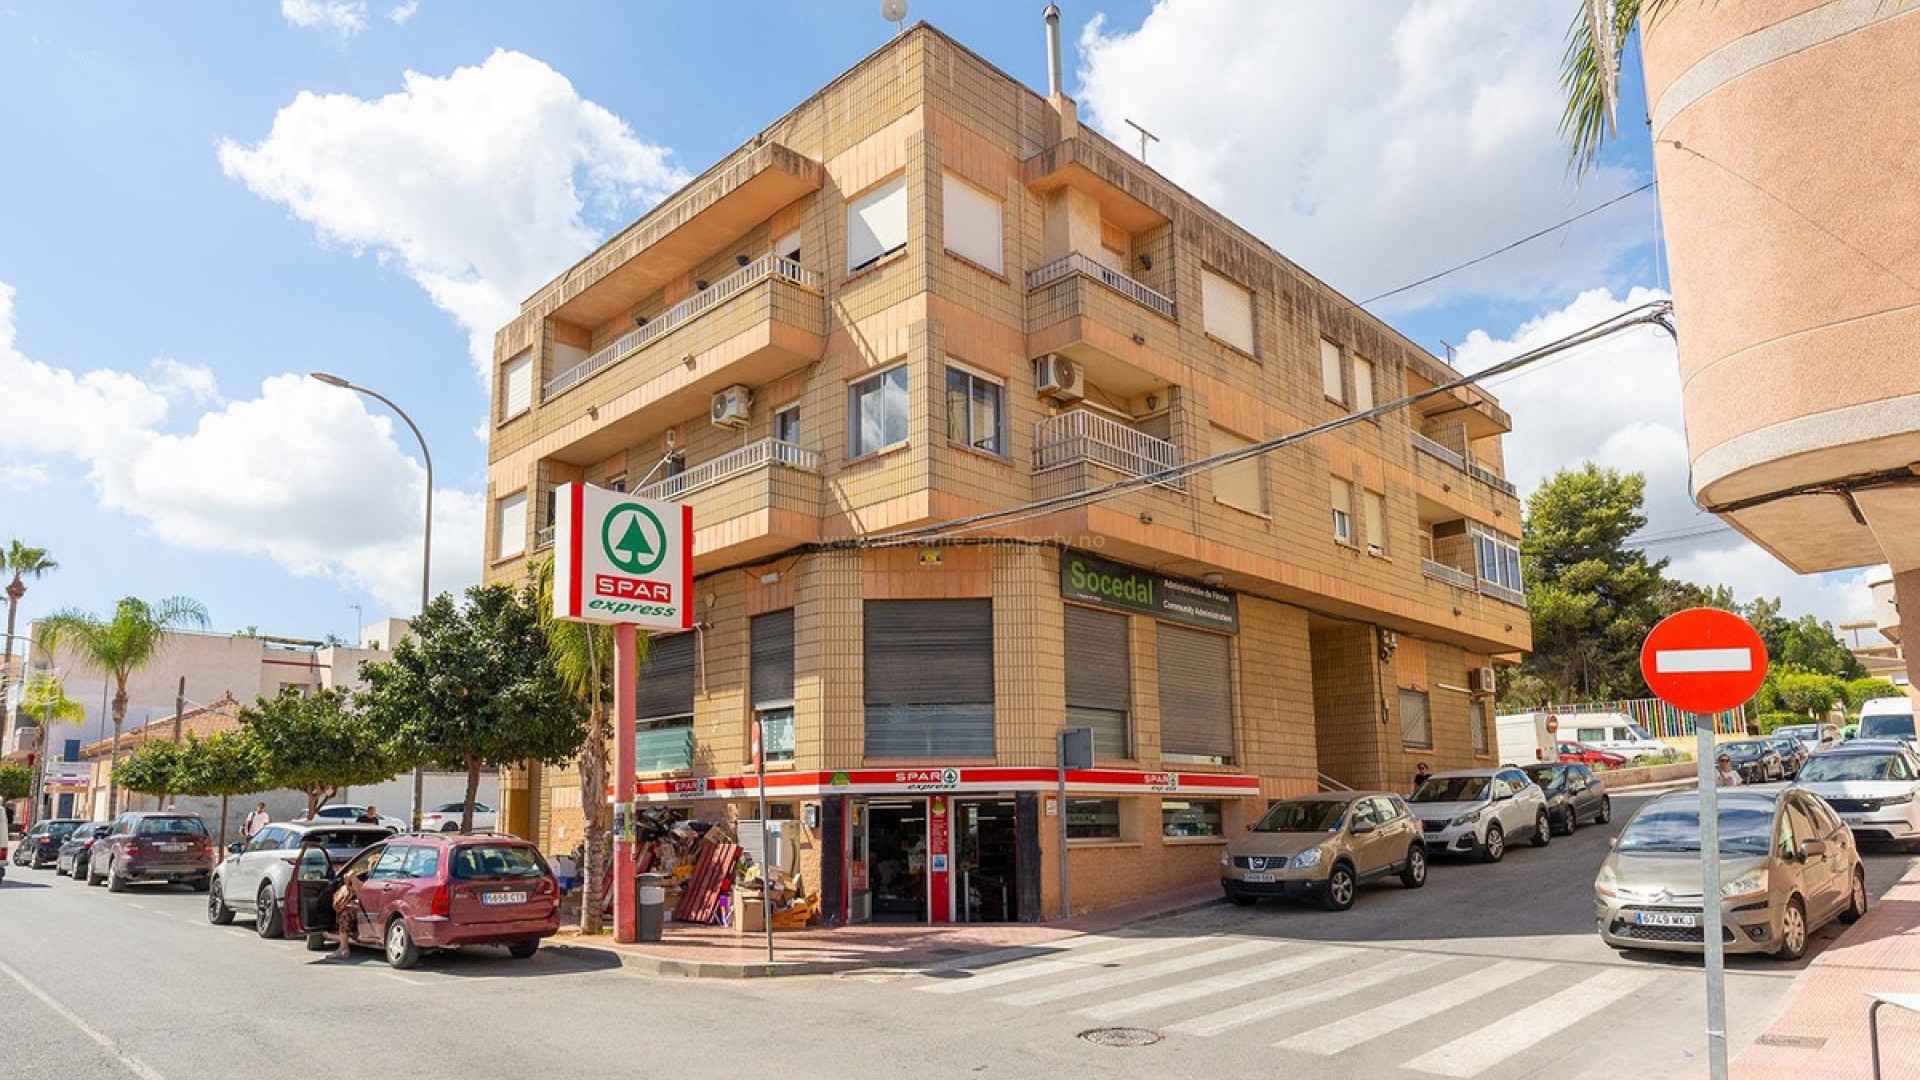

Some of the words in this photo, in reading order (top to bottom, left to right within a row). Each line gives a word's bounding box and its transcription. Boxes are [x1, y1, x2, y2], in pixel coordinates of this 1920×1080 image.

[599, 577, 670, 600] SPAR
[1071, 560, 1153, 605] Socedal
[589, 600, 676, 617] express
[1163, 599, 1195, 616] Community
[896, 771, 941, 781] SPAR
[1144, 774, 1168, 784] SPAR
[675, 781, 697, 792] SPAR
